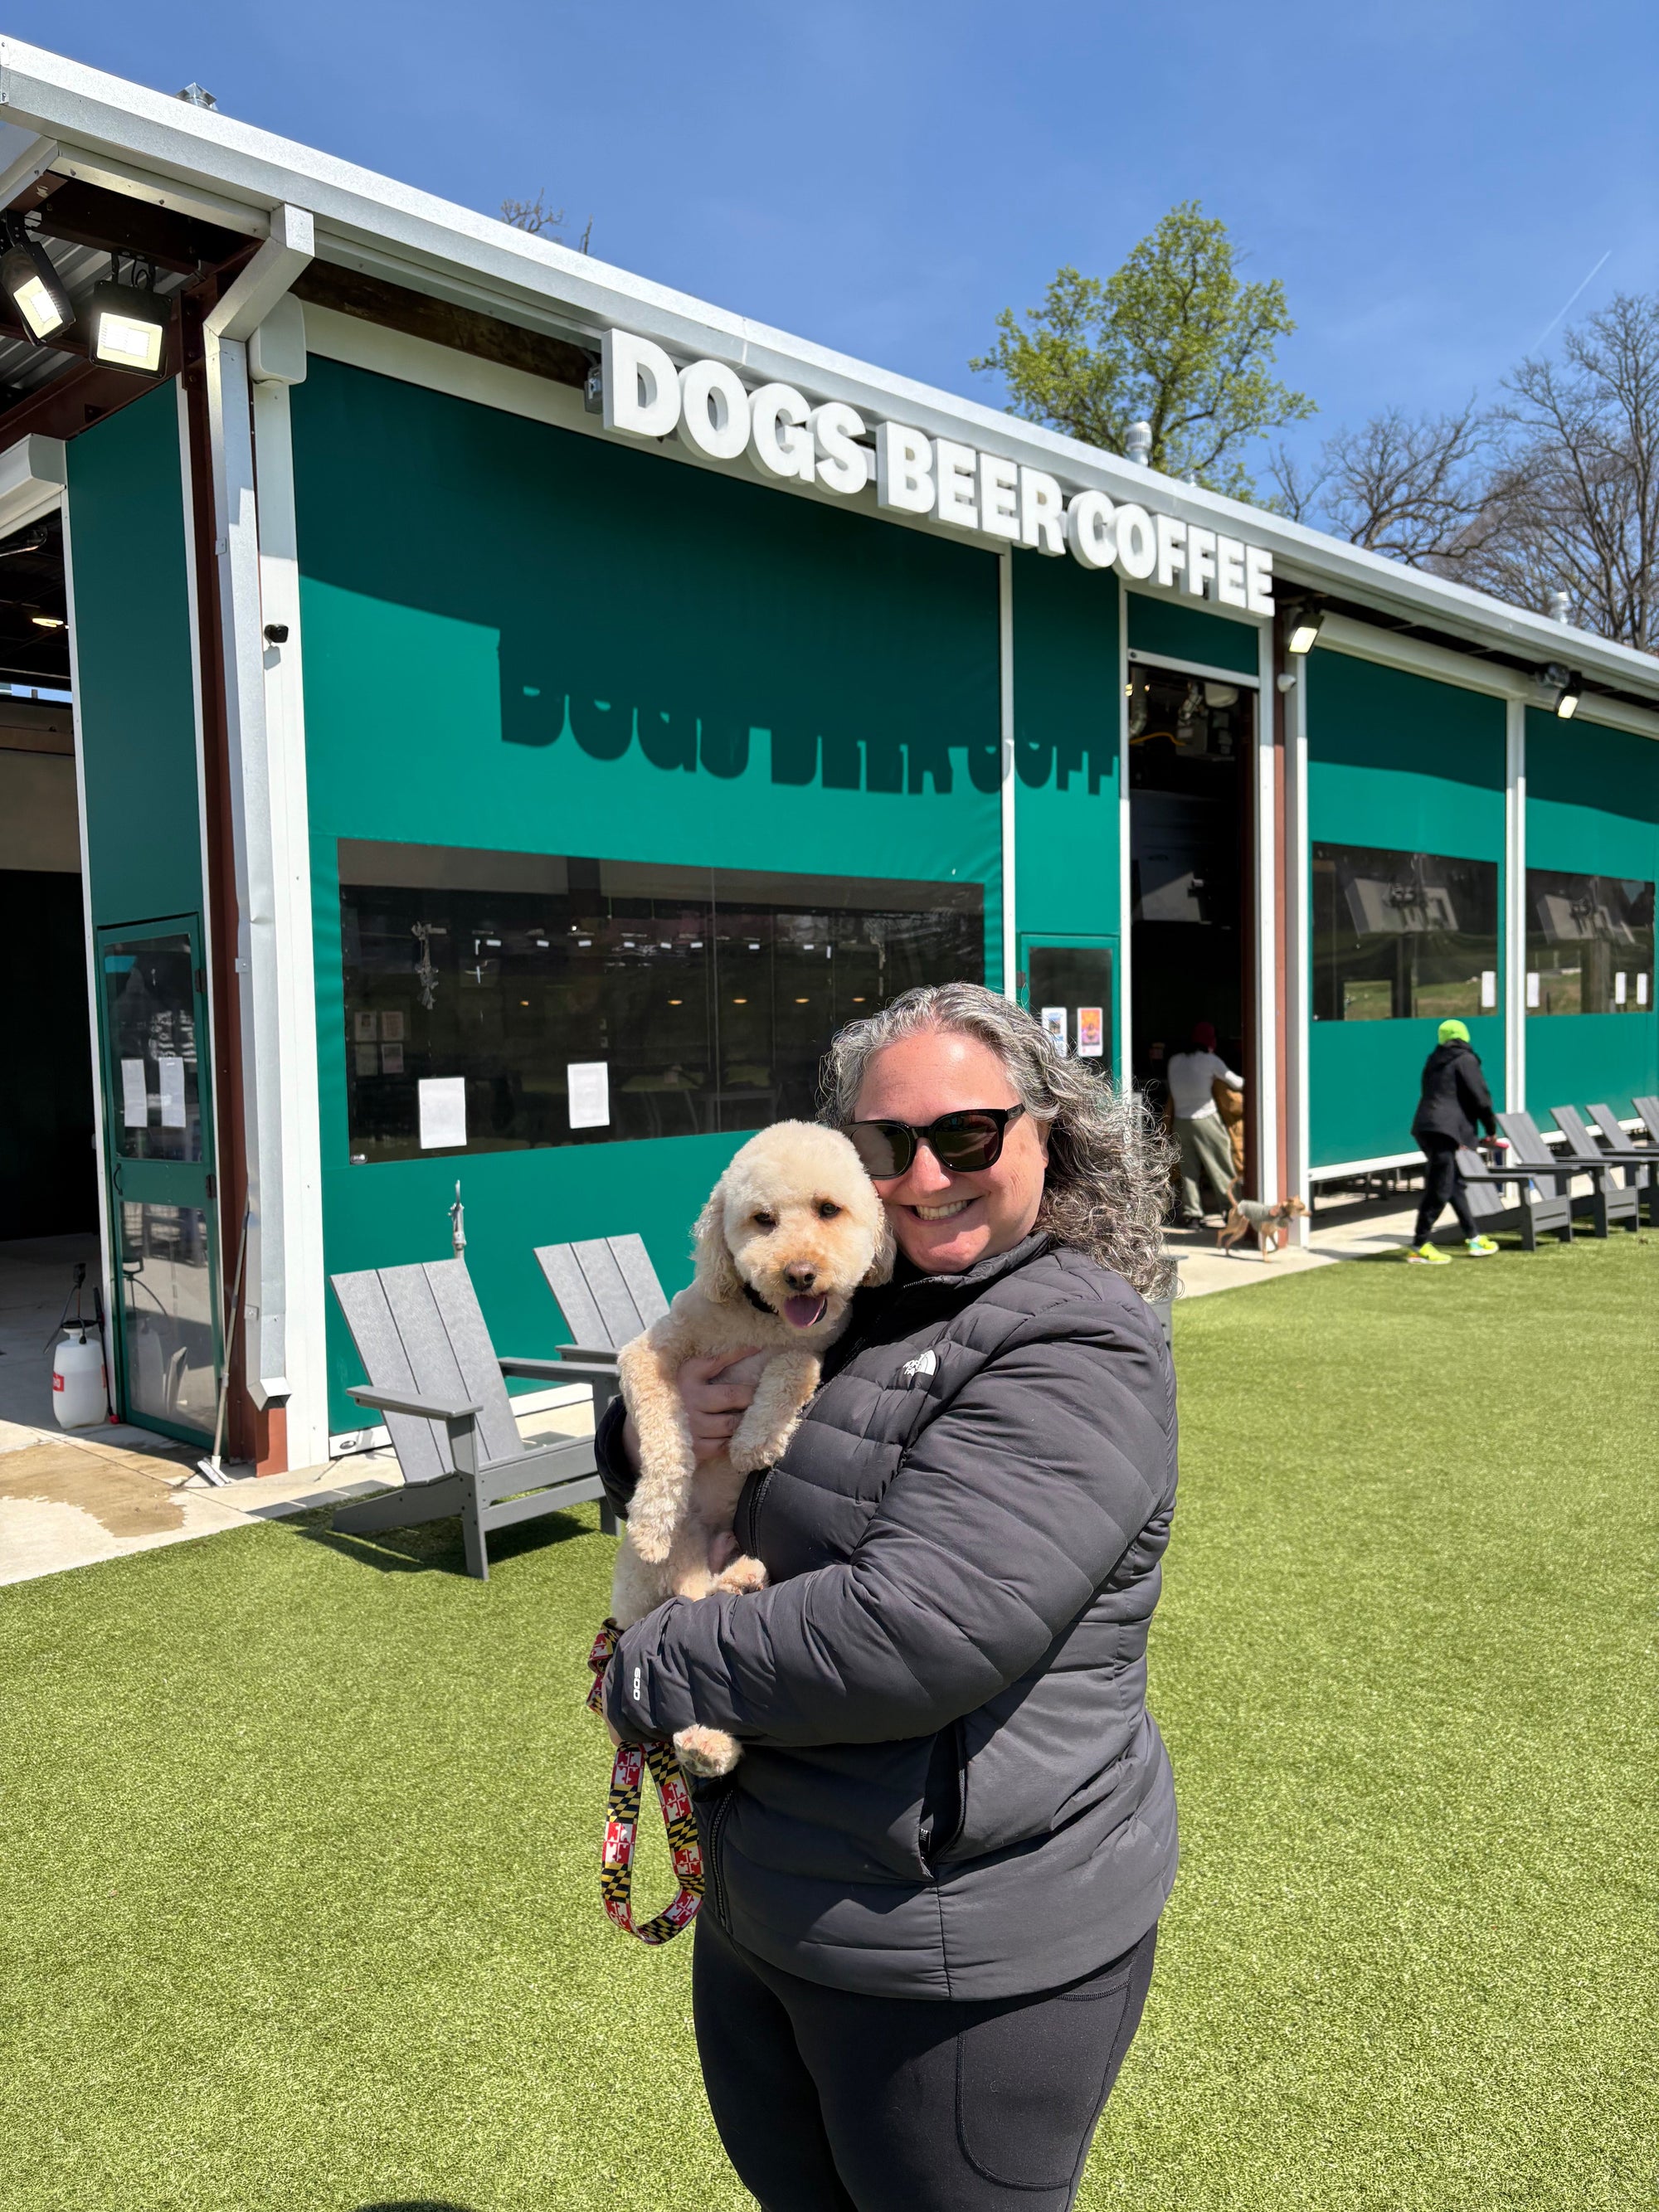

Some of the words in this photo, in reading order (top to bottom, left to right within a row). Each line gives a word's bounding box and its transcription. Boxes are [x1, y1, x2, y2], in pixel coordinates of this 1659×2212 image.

[603, 328, 868, 495] DOGS
[877, 421, 1066, 557] BEER
[1068, 490, 1275, 618] COFFEE
